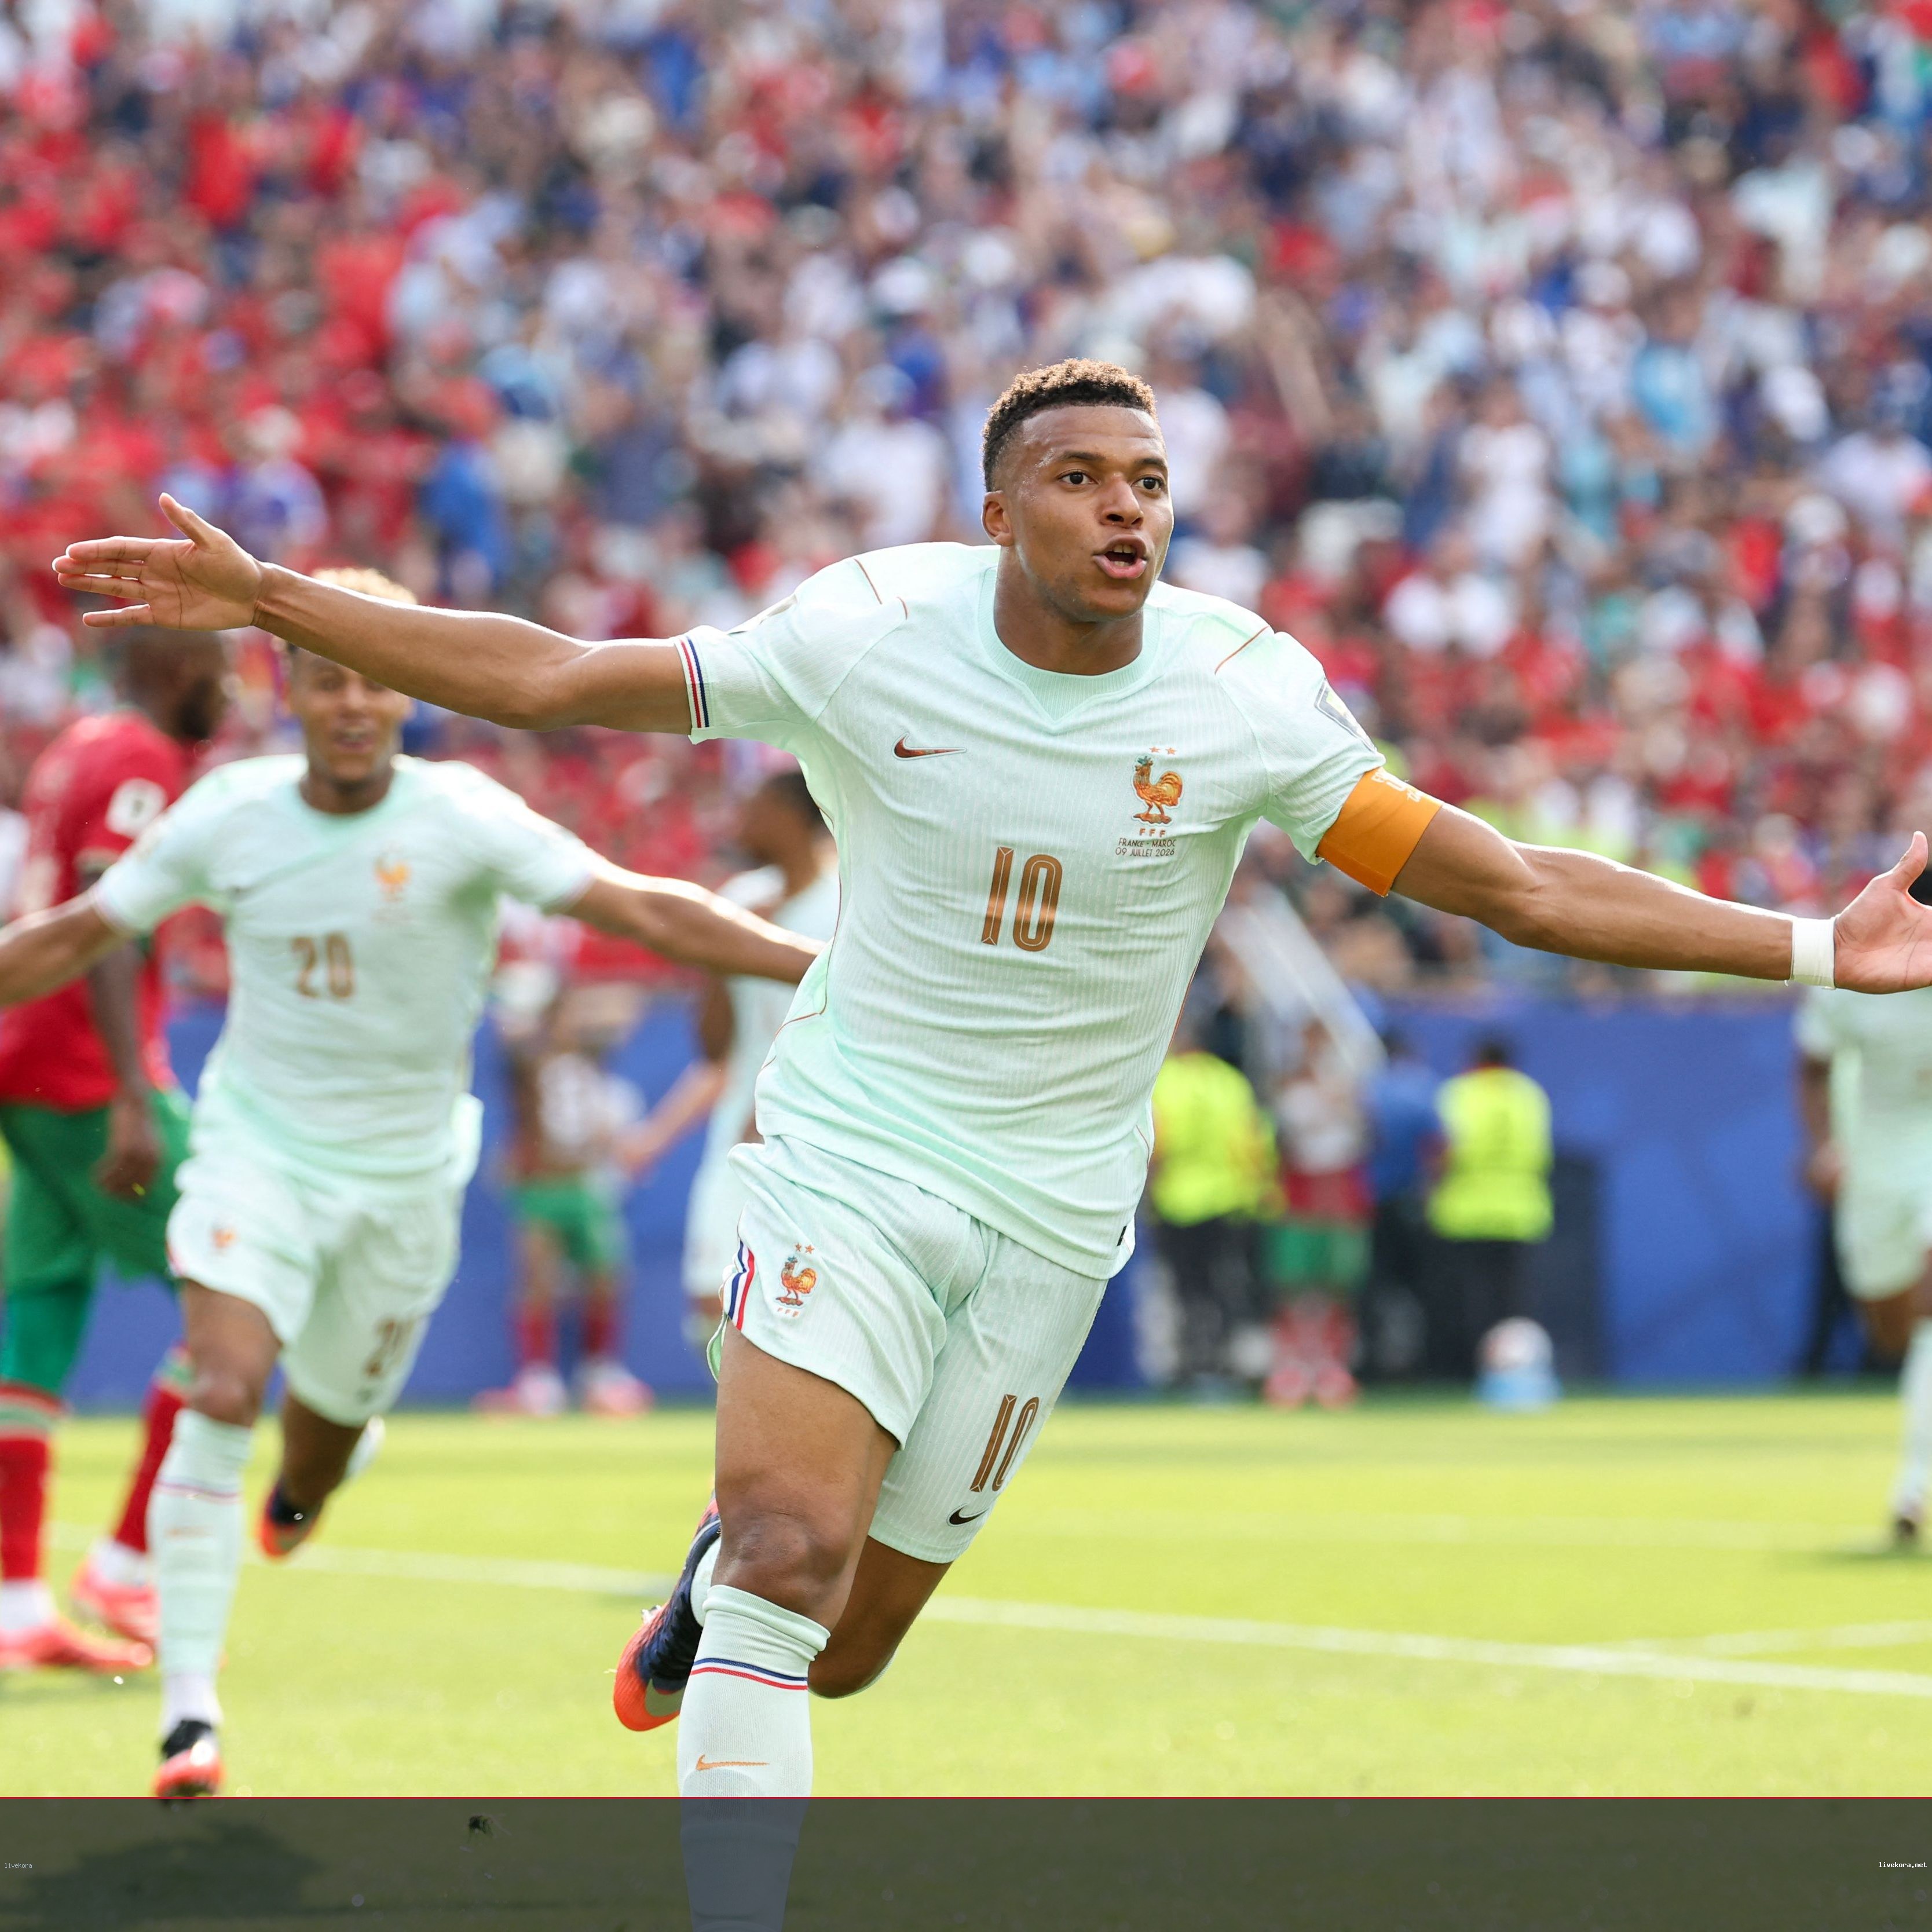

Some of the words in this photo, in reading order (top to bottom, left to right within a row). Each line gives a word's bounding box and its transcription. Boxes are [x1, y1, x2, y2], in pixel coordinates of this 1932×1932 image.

[1115, 847, 1127, 855] 09
[1130, 848, 1153, 857] JUILLET
[1156, 848, 1174, 857] 2026
[1118, 837, 1144, 847] FRANCE
[1152, 839, 1177, 847] MAROC
[981, 846, 1063, 952] 10
[291, 930, 356, 1002] 20
[969, 1393, 1040, 1494] 10
